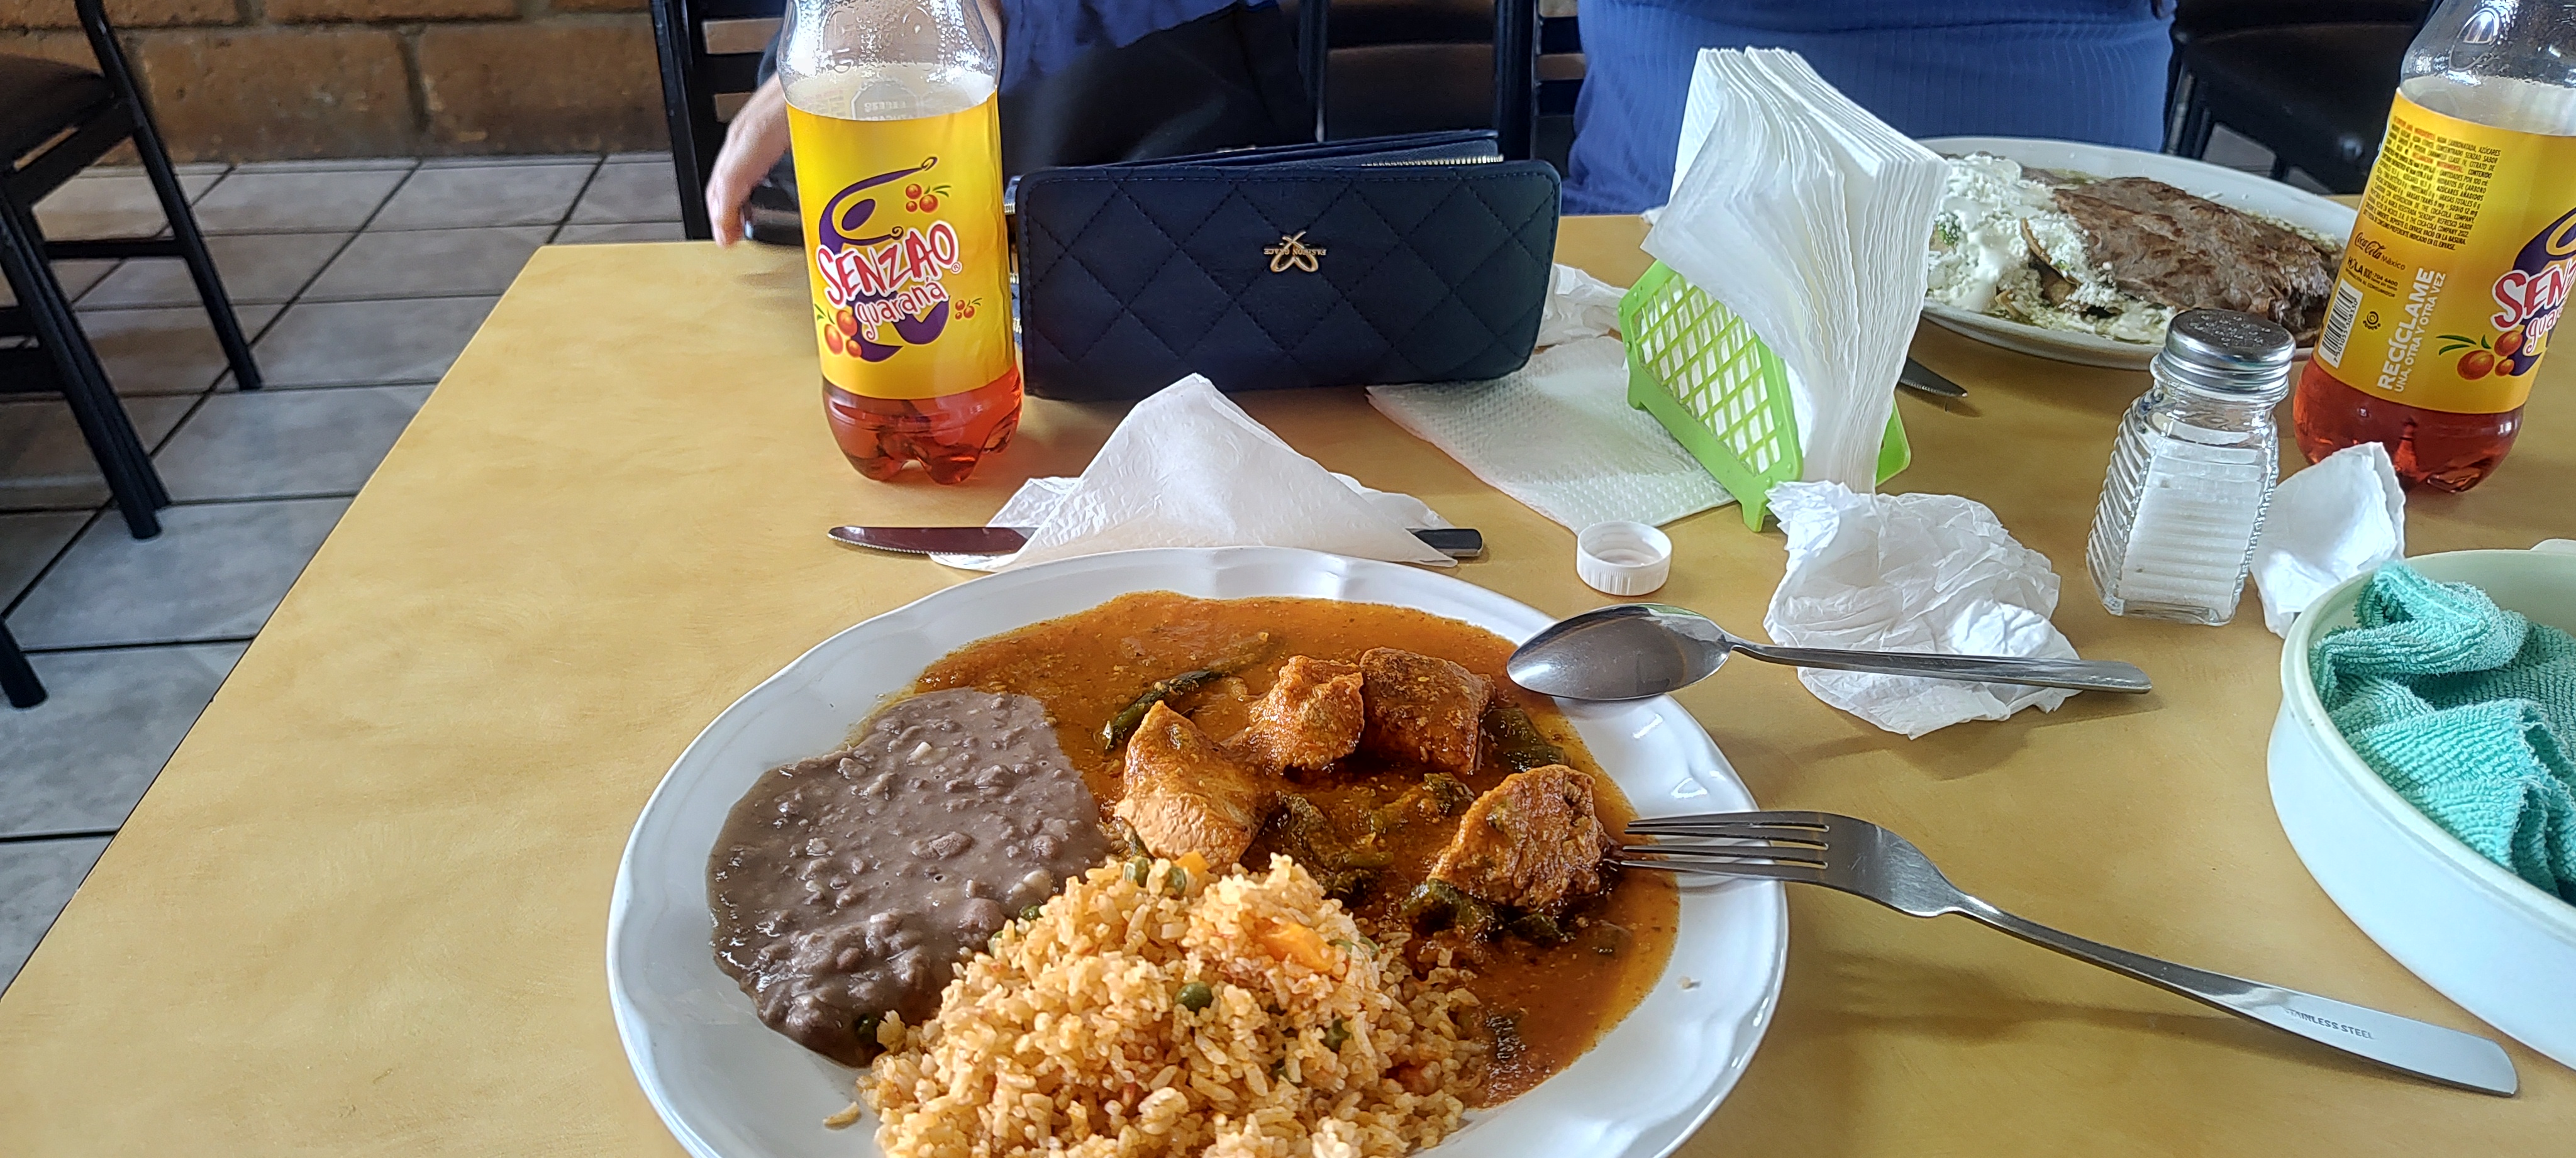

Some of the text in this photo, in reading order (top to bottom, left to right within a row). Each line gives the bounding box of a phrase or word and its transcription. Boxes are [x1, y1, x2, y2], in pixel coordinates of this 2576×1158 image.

[818, 221, 956, 306] SENZAO
[856, 277, 948, 341] guaraná
[2377, 267, 2435, 390] RECÍCLAME
[2395, 272, 2446, 392] UNA, OTRA Y OTRA VEZ
[2341, 1025, 2374, 1039] STEEL
